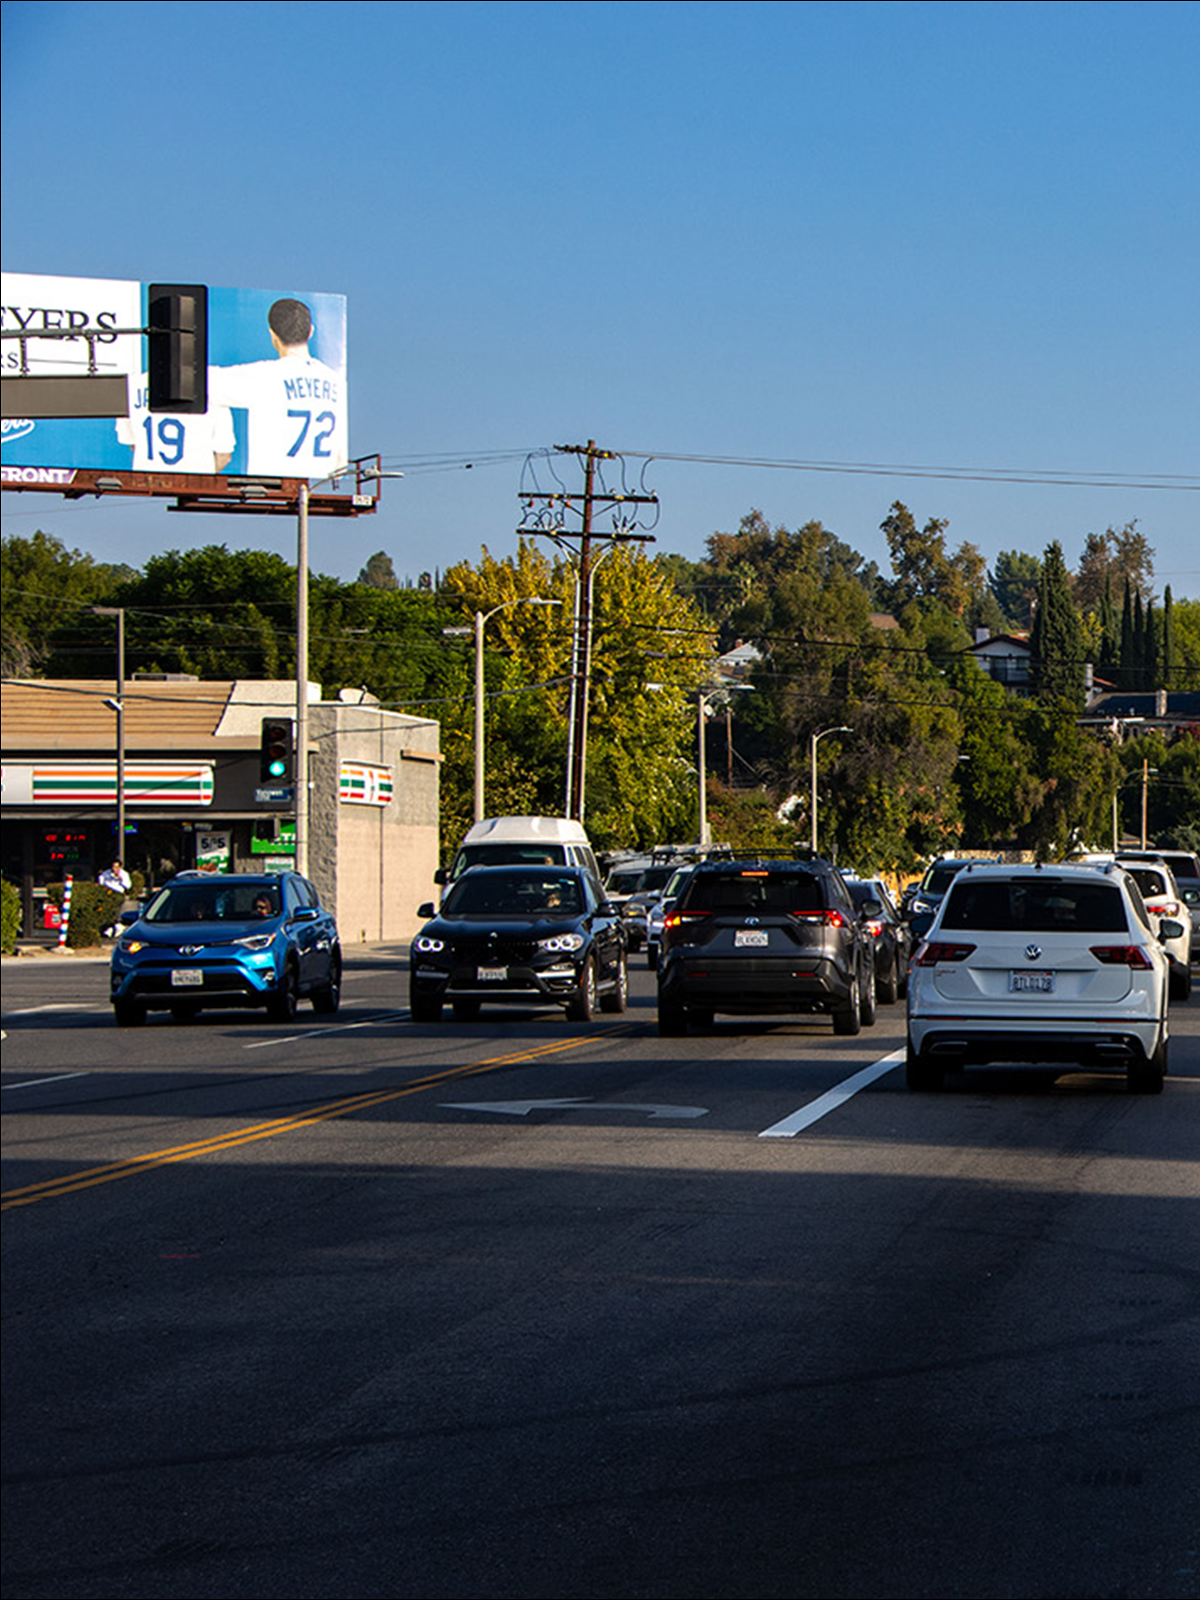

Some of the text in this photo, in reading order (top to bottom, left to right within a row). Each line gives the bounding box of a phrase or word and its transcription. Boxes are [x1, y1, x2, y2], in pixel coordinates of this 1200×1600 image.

[1, 306, 118, 344] YERS
[284, 377, 338, 403] MEYERS
[142, 415, 186, 466] 19
[286, 409, 337, 457] 72
